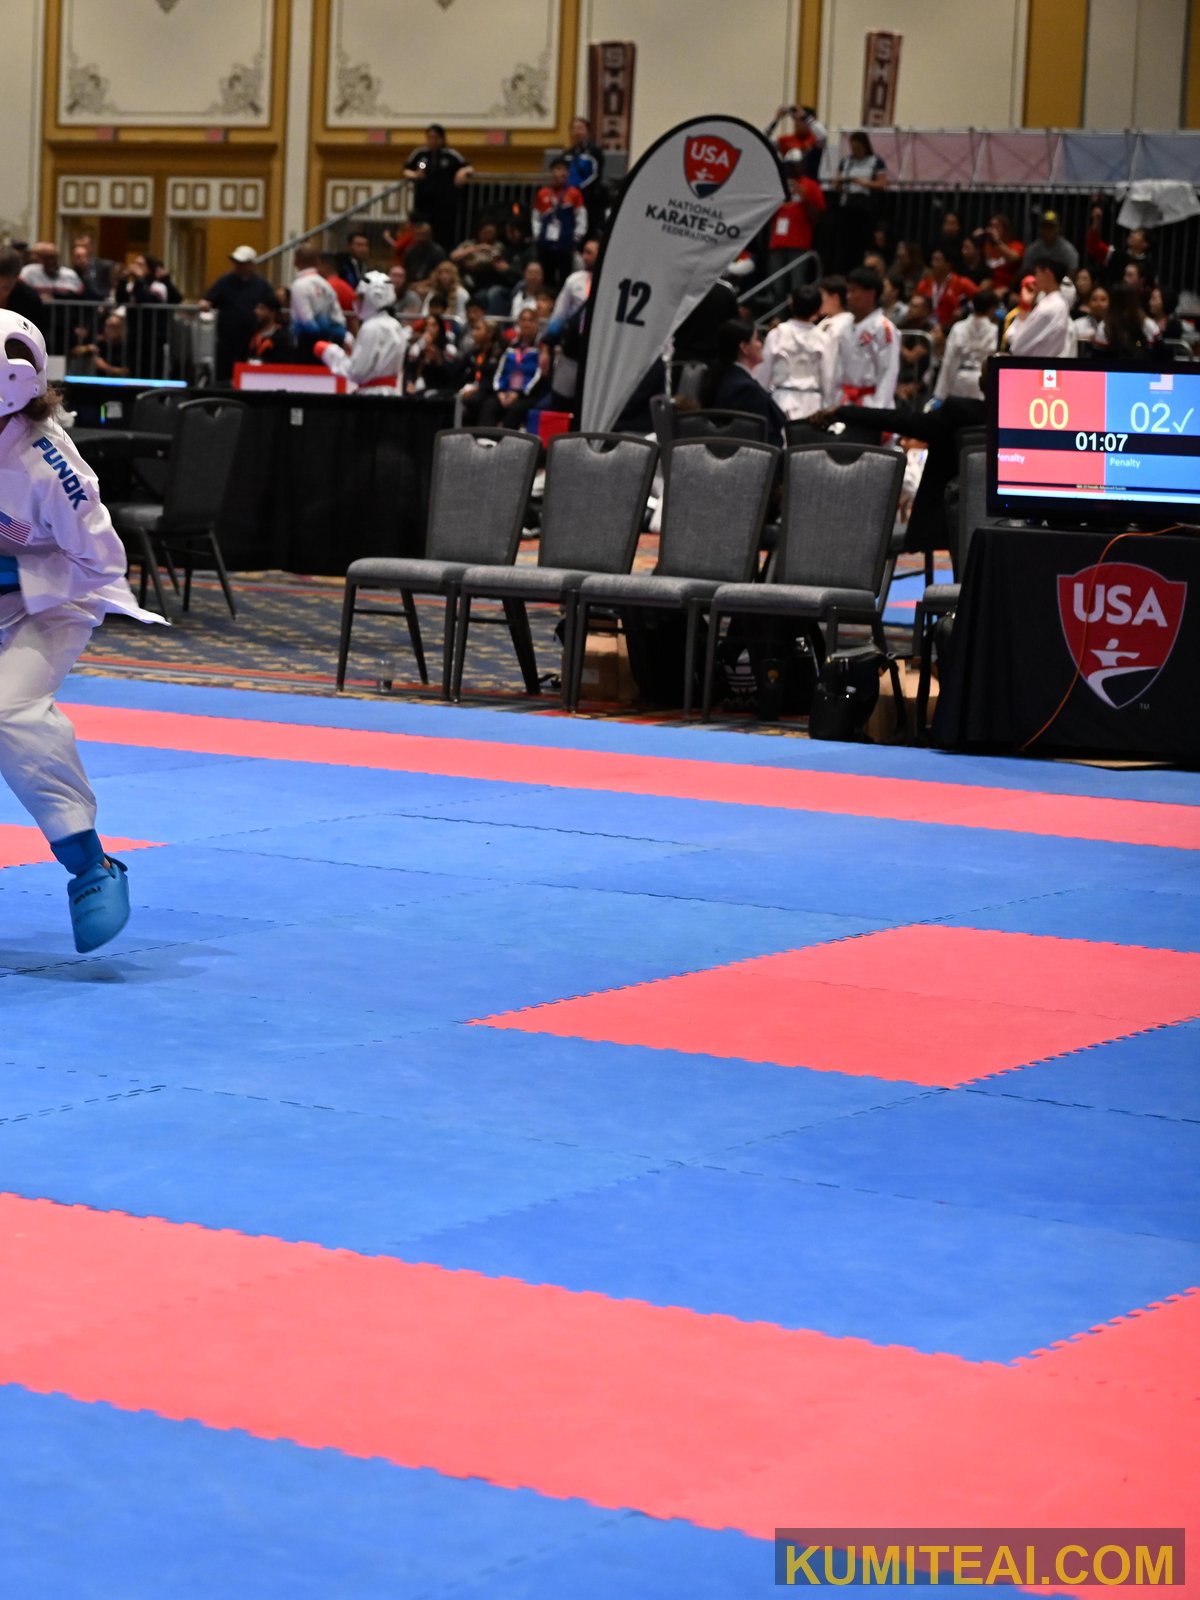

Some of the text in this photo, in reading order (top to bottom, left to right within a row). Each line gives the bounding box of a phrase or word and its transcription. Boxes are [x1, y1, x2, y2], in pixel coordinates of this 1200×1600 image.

[690, 141, 730, 169] USA
[644, 204, 742, 240] KARATE-DO
[667, 198, 725, 220] NATIONAL
[615, 278, 652, 327] 12
[1029, 398, 1171, 433] 00 02
[1075, 432, 1128, 452] 01:07
[32, 436, 88, 511] PUNOK
[1109, 456, 1142, 469] Penalty
[1073, 582, 1168, 628] USA
